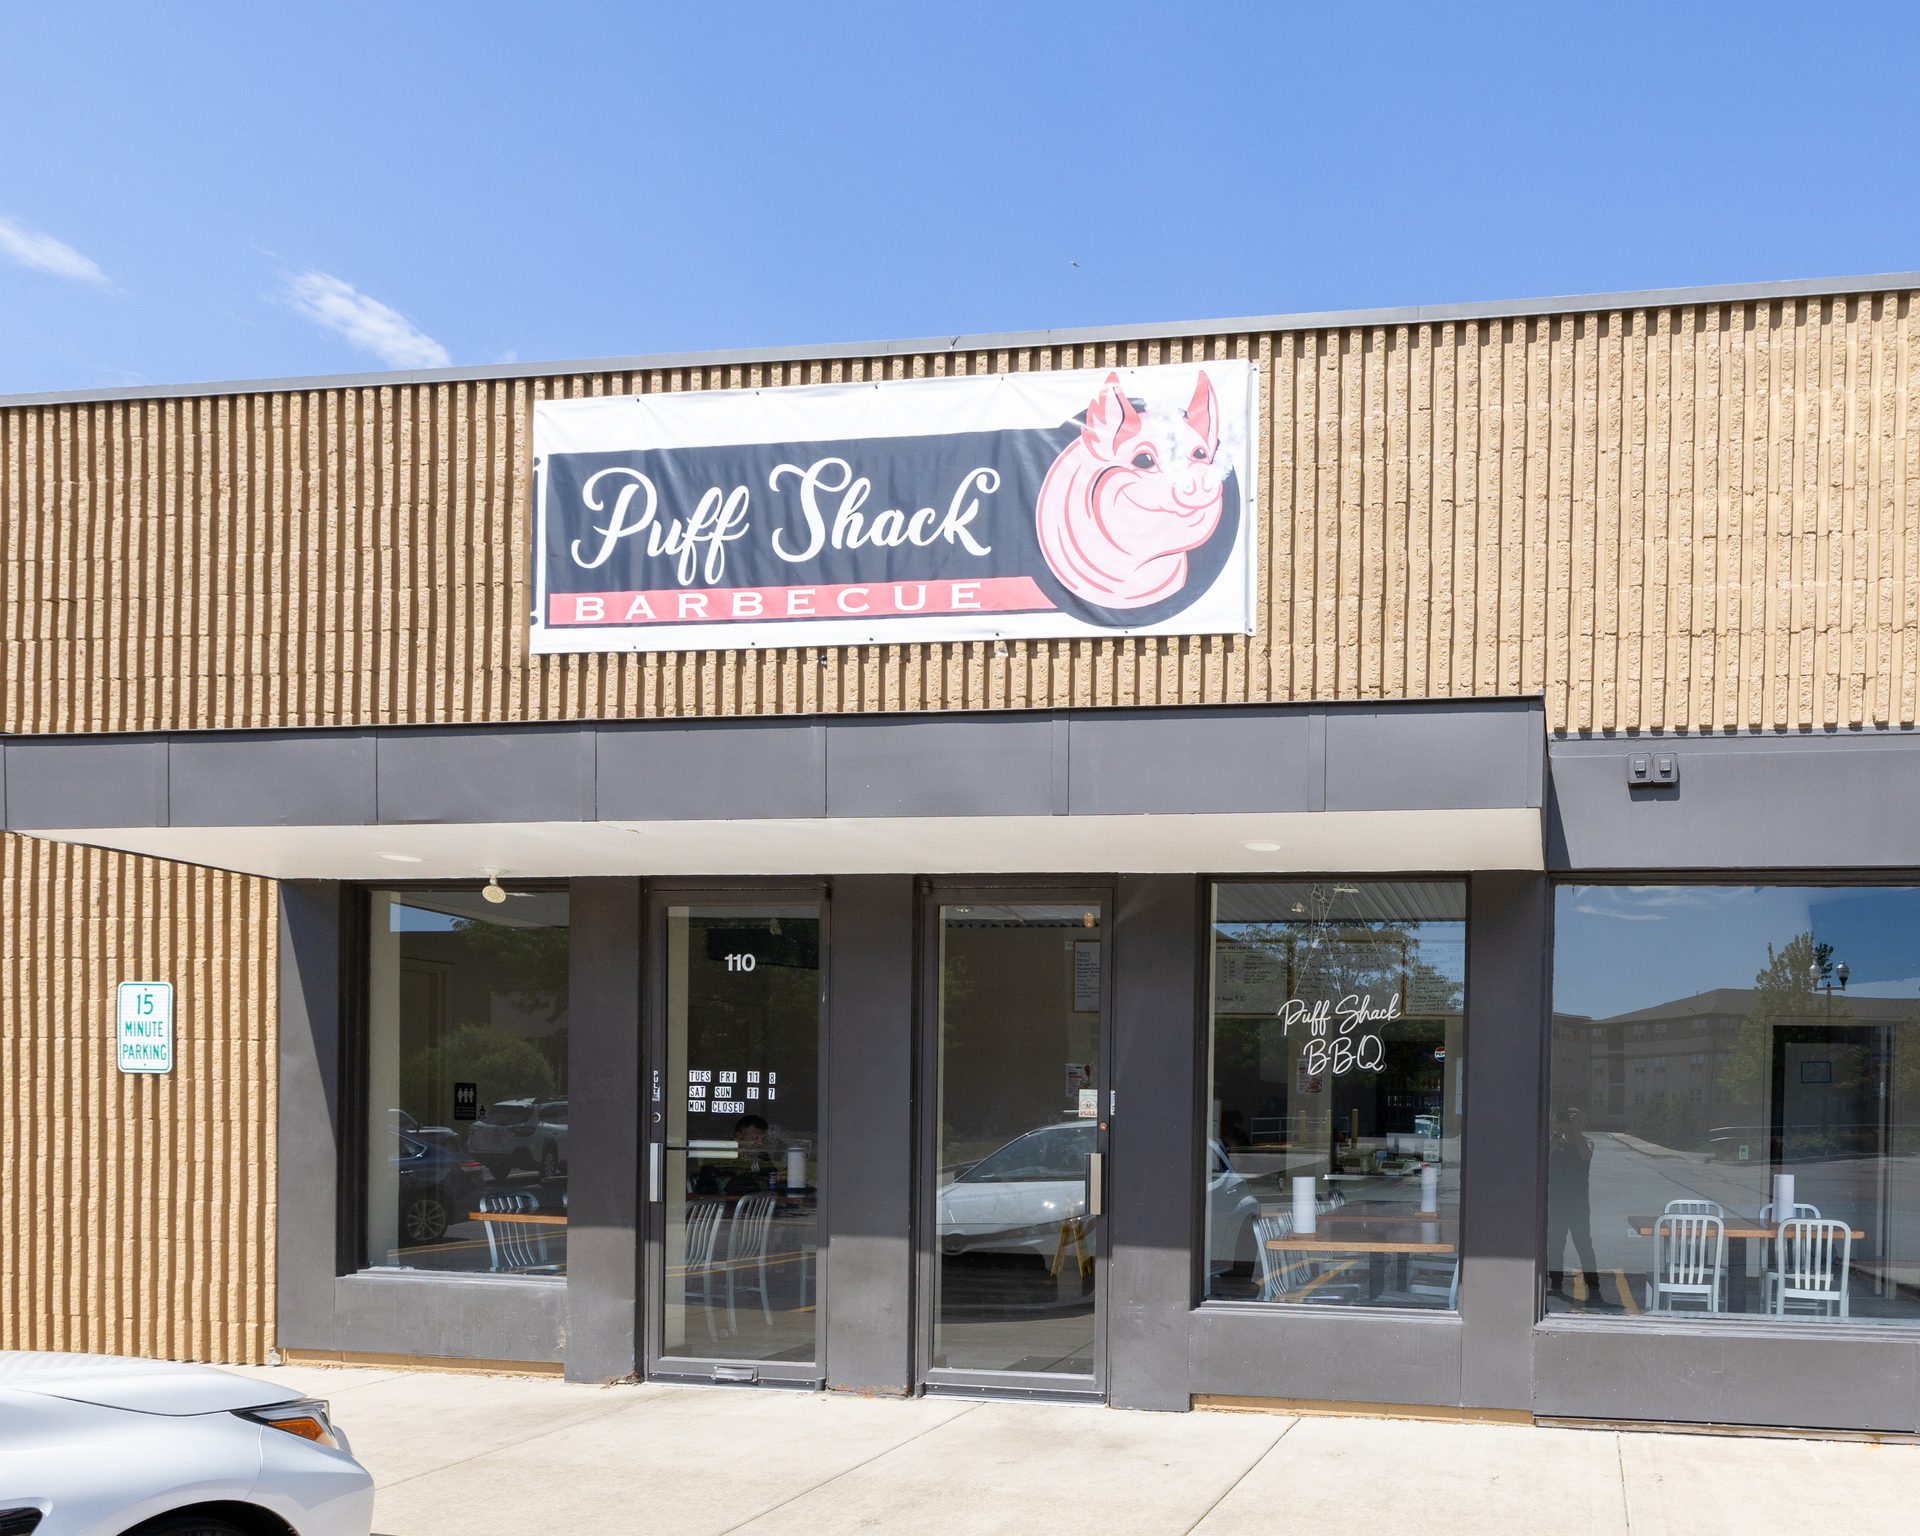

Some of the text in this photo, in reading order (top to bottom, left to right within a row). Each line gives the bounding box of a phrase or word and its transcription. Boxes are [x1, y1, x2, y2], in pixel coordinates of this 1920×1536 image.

[570, 456, 1001, 586] Puff Shack
[573, 581, 984, 622] BARBECUE
[725, 953, 756, 972] 110
[136, 994, 154, 1015] 15
[1277, 992, 1401, 1036] Puff Shack
[125, 1021, 164, 1037] MINUTE
[122, 1044, 167, 1060] PARKING
[1303, 1034, 1384, 1076] BBQ
[690, 1071, 775, 1084] TUES FRI 11 8
[689, 1086, 775, 1099] SAT SUN 11 7
[689, 1101, 744, 1113] MON CLOSED
